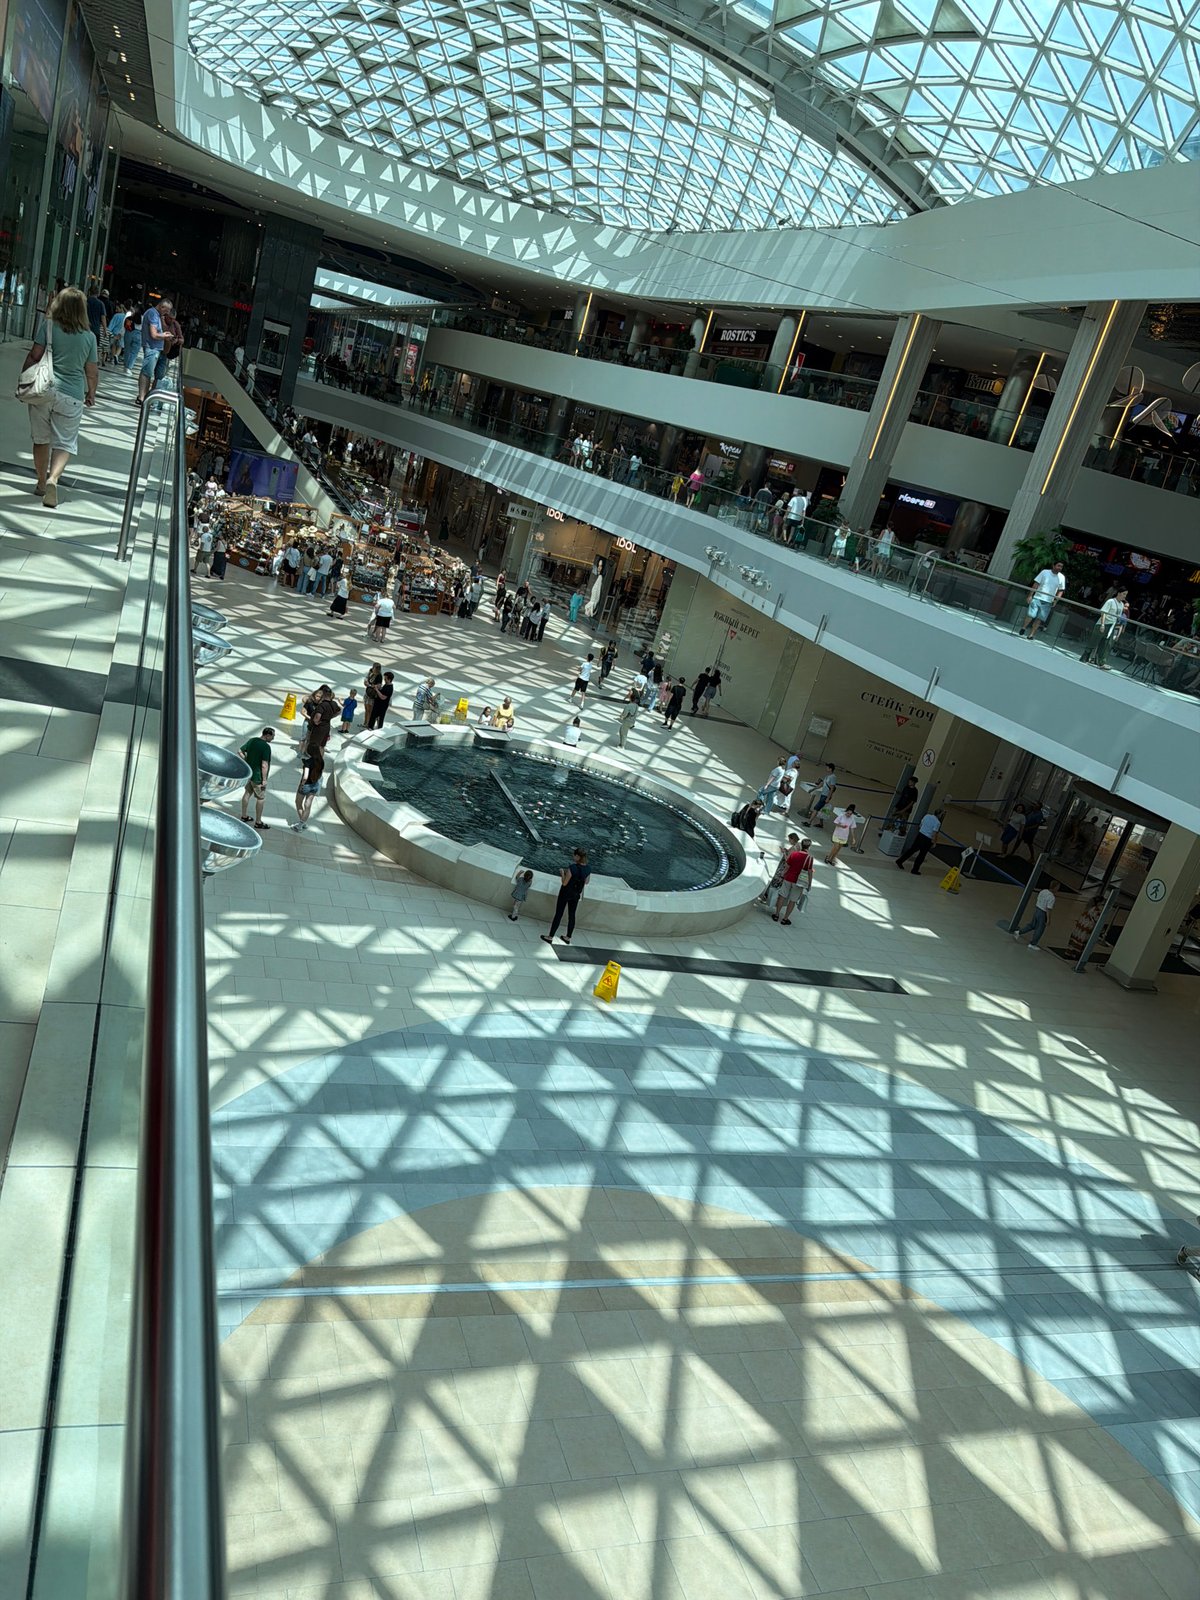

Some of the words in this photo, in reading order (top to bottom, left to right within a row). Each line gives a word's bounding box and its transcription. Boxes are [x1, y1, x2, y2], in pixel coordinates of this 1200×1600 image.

[720, 329, 757, 342] ROSTIC'S
[546, 507, 565, 523] IDOL
[616, 536, 637, 554] IDOL
[740, 623, 760, 639] БЕРЕГ
[861, 691, 904, 712] СТЕЙК
[909, 705, 935, 722] ТОЧ
